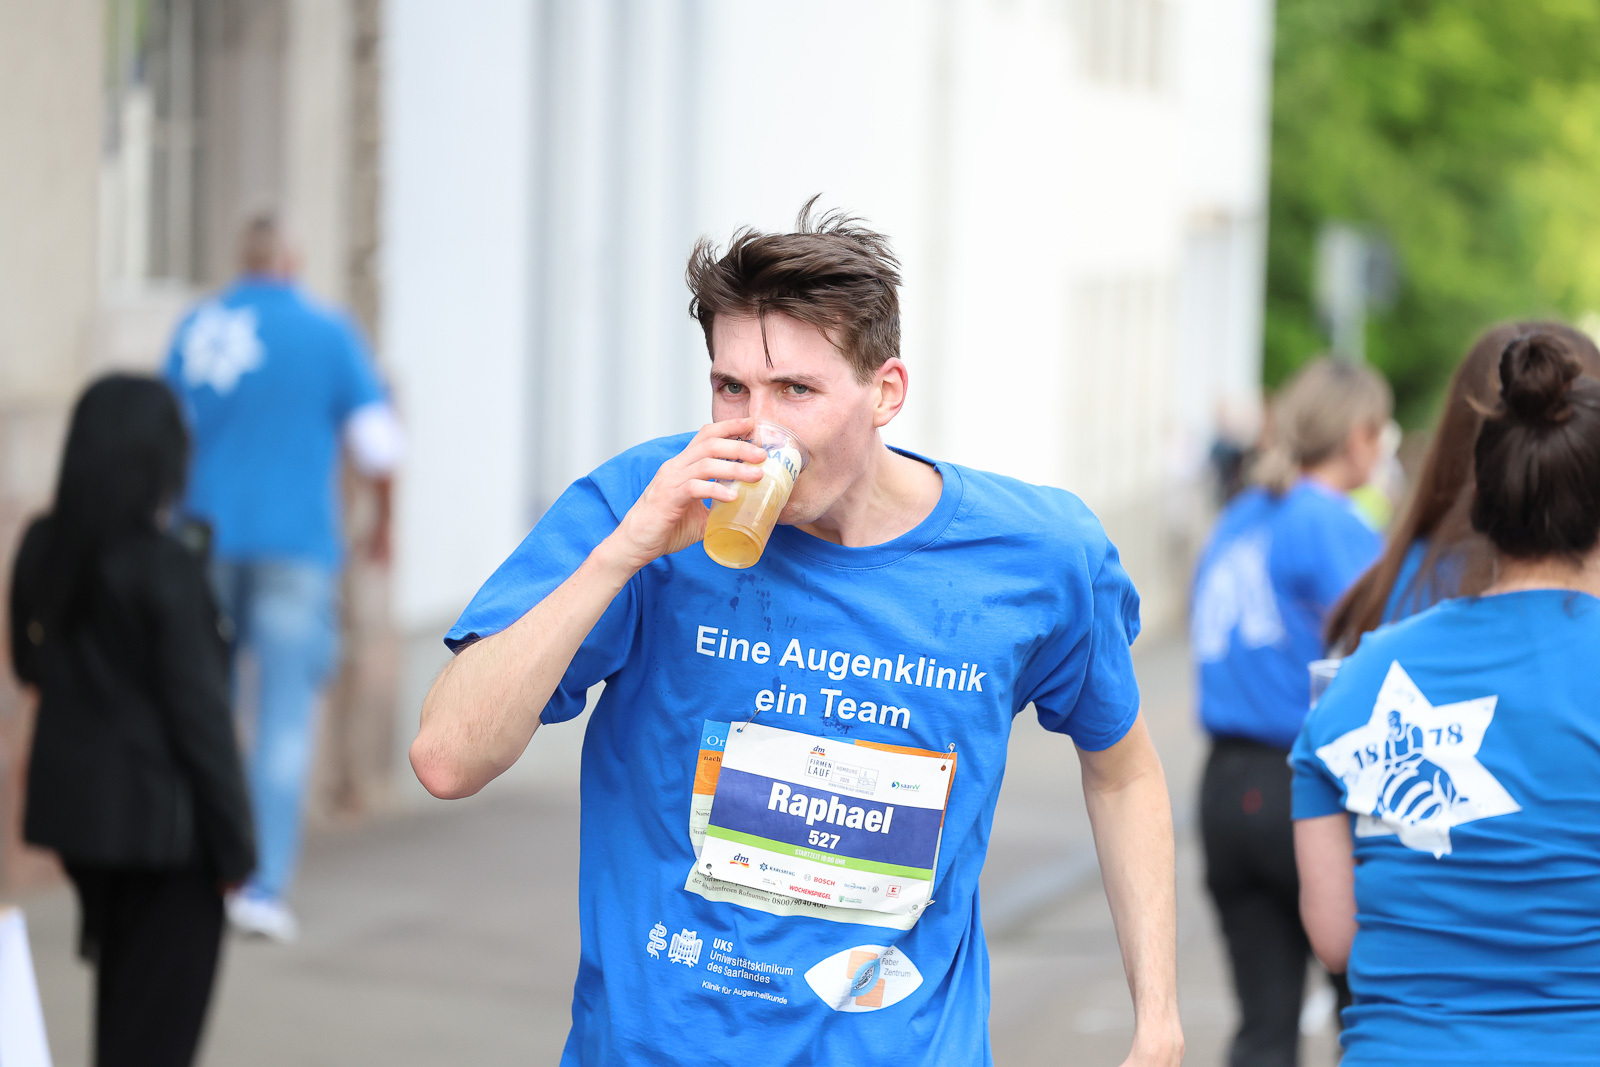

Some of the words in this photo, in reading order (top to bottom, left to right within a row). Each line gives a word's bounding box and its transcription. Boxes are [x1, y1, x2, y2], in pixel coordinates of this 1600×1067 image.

[696, 625, 770, 664] Eine
[779, 638, 987, 692] Augenklinik
[755, 684, 807, 715] ein
[820, 688, 911, 729] Team
[813, 745, 825, 753] dm
[1354, 743, 1378, 769] 18
[1428, 723, 1463, 746] 78
[809, 758, 832, 769] FIRMEN
[807, 765, 830, 778] LAUF
[768, 781, 894, 834] Raphael
[808, 829, 841, 850] 527
[733, 853, 749, 864] dm
[794, 848, 820, 860] STARTZEIT
[813, 876, 836, 887] BOSCH
[789, 884, 831, 900] WOCHENSPIEGEL
[713, 938, 734, 953] UKS
[710, 949, 794, 976] Universitätsklinikum
[881, 957, 899, 967] Faber
[707, 961, 723, 974] des
[723, 965, 771, 984] Saarlandes
[883, 967, 911, 978] Zentrum
[702, 980, 720, 993] Klinik
[721, 985, 732, 995] für
[732, 987, 788, 1005] Augenheilkunde
